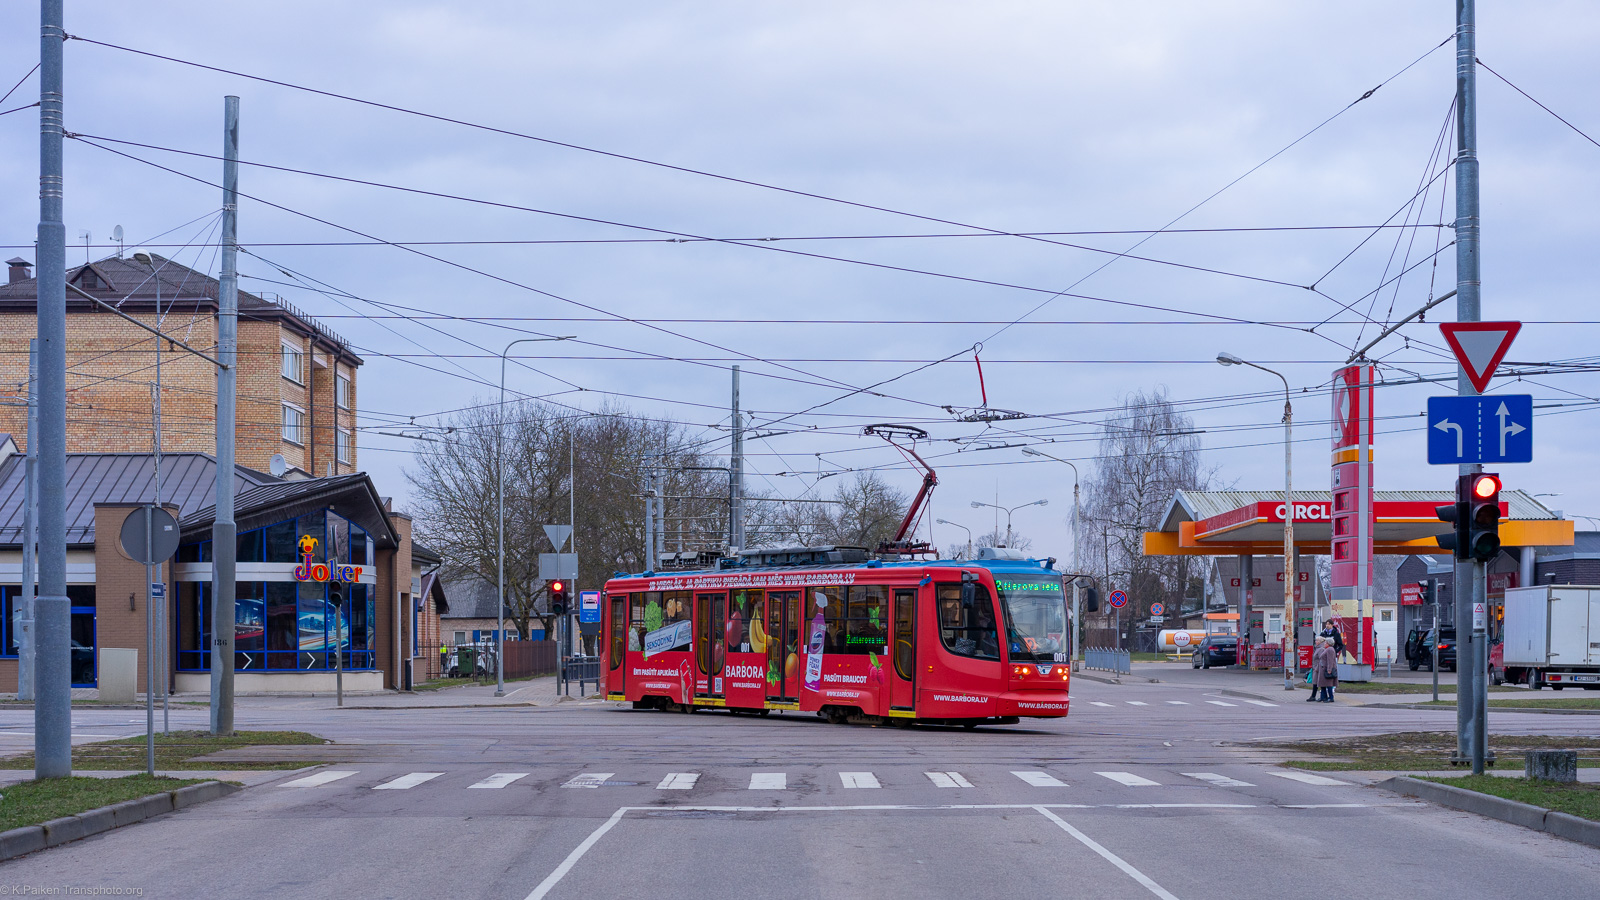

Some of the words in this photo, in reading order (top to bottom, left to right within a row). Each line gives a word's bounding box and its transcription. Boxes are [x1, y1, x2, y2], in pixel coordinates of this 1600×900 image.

[1275, 504, 1331, 519] CIRCL
[295, 552, 363, 583] Joker
[995, 580, 1003, 591] 2
[646, 634, 673, 651] SENSODYNE
[740, 642, 750, 653] 001
[1053, 652, 1067, 662] 001
[725, 665, 764, 678] BARBORA
[823, 673, 841, 682] PASŪTI
[842, 674, 867, 684] BRAUCOT
[826, 690, 860, 698] WWW.BARBORA.LV
[934, 694, 988, 703] WWW.BARBORA.LV
[1018, 702, 1068, 710] WWW.BARBORA.LV
